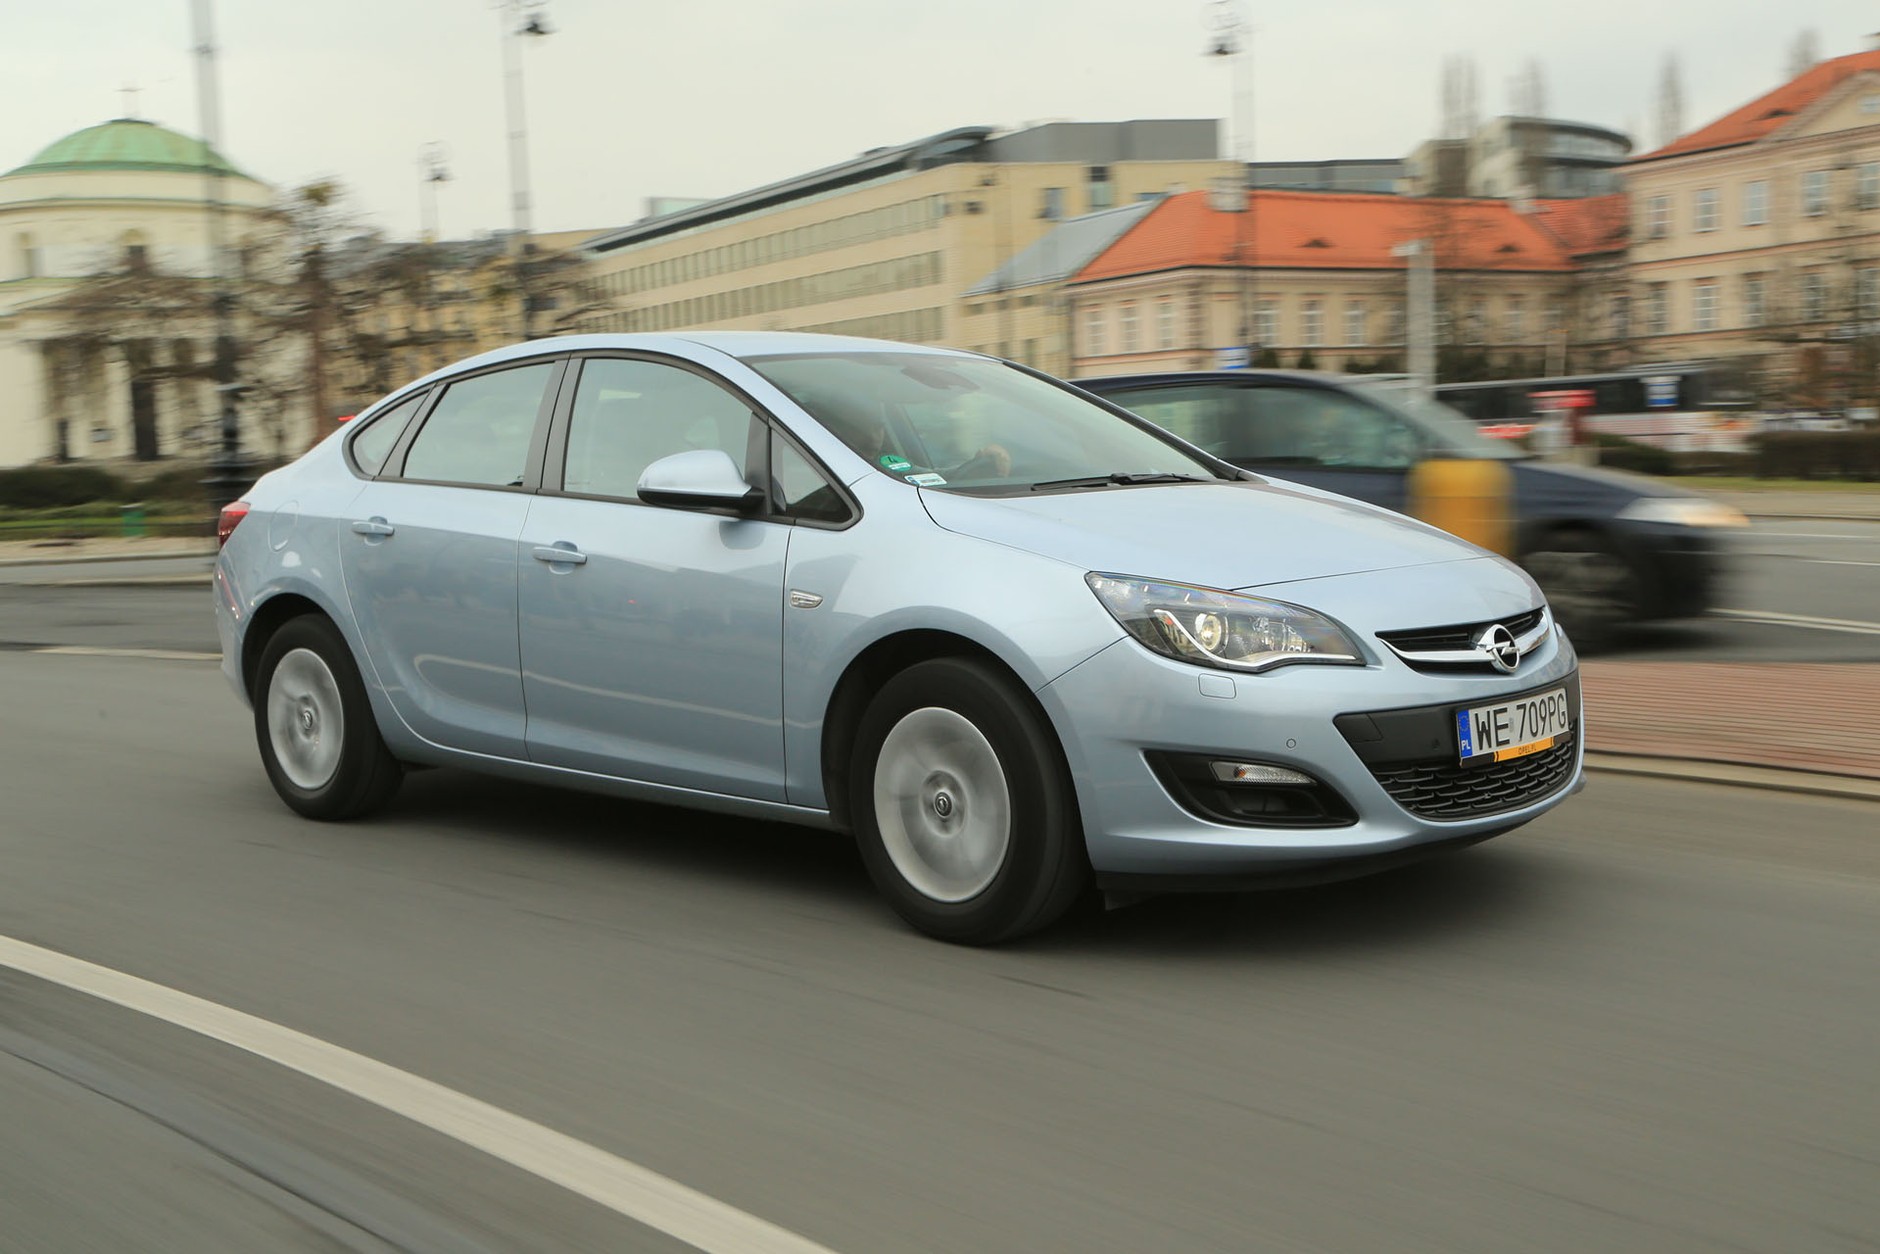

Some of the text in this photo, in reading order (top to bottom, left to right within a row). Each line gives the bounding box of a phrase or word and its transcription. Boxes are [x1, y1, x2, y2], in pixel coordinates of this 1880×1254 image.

[1475, 693, 1566, 750] WE 709PG
[1461, 740, 1471, 751] PL
